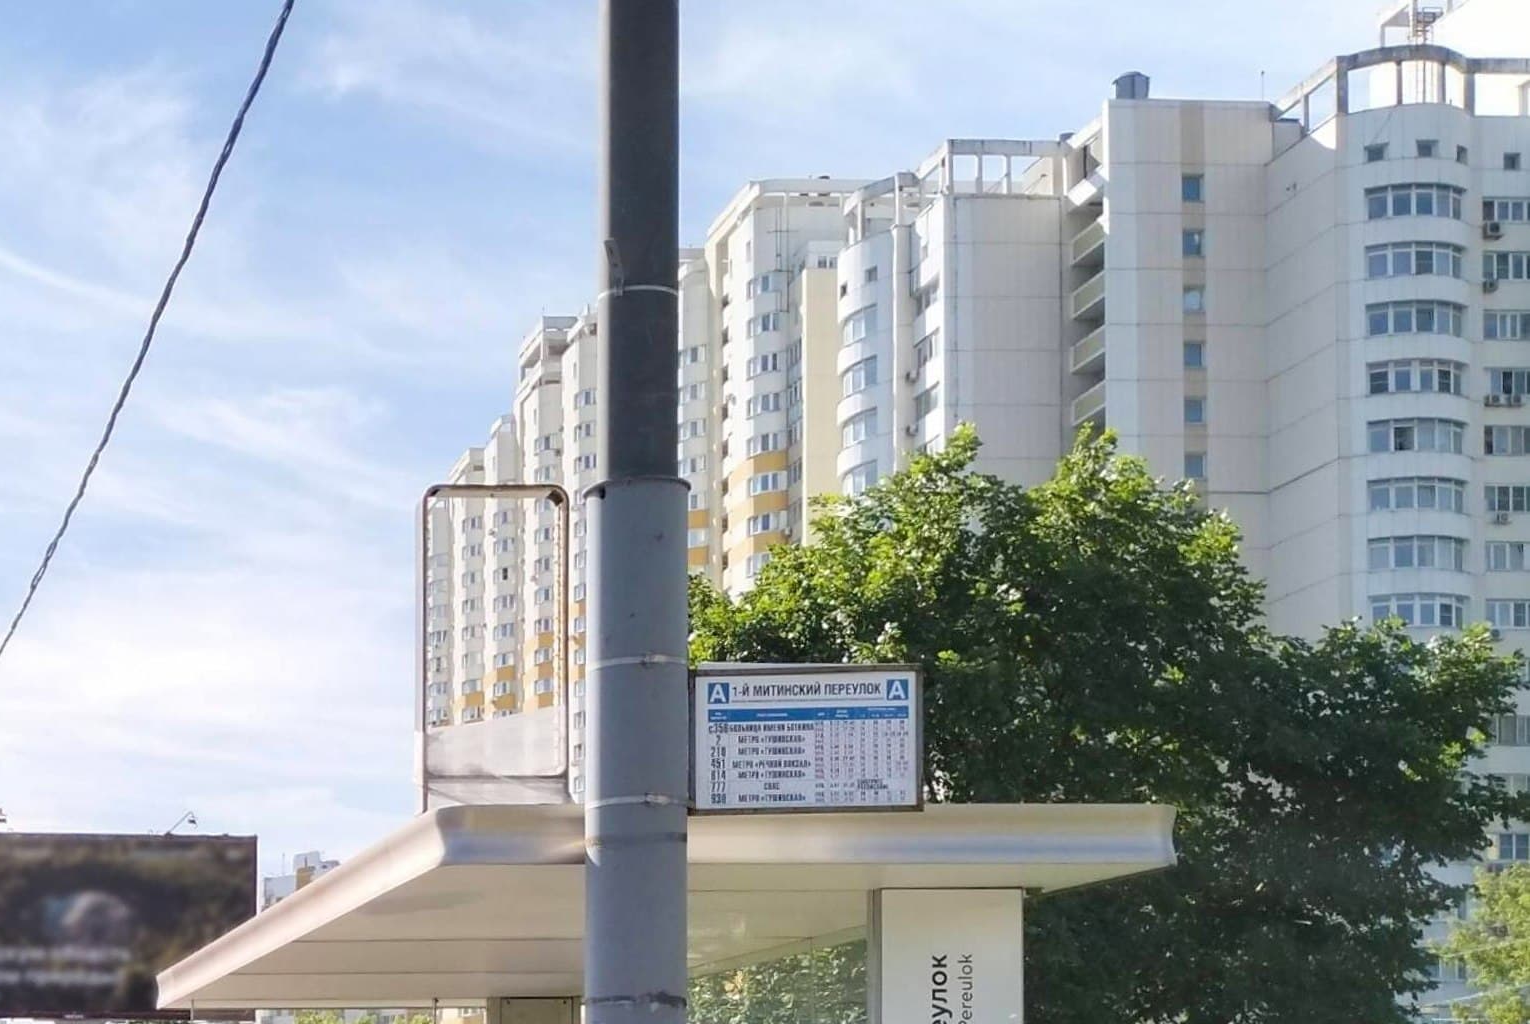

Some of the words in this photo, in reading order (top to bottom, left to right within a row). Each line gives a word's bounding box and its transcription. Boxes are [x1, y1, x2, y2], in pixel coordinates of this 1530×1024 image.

[732, 682, 750, 697] 1-Й
[753, 681, 821, 697] МИТИНСКИЙ
[824, 682, 881, 696] ПЕРЕУЛОК
